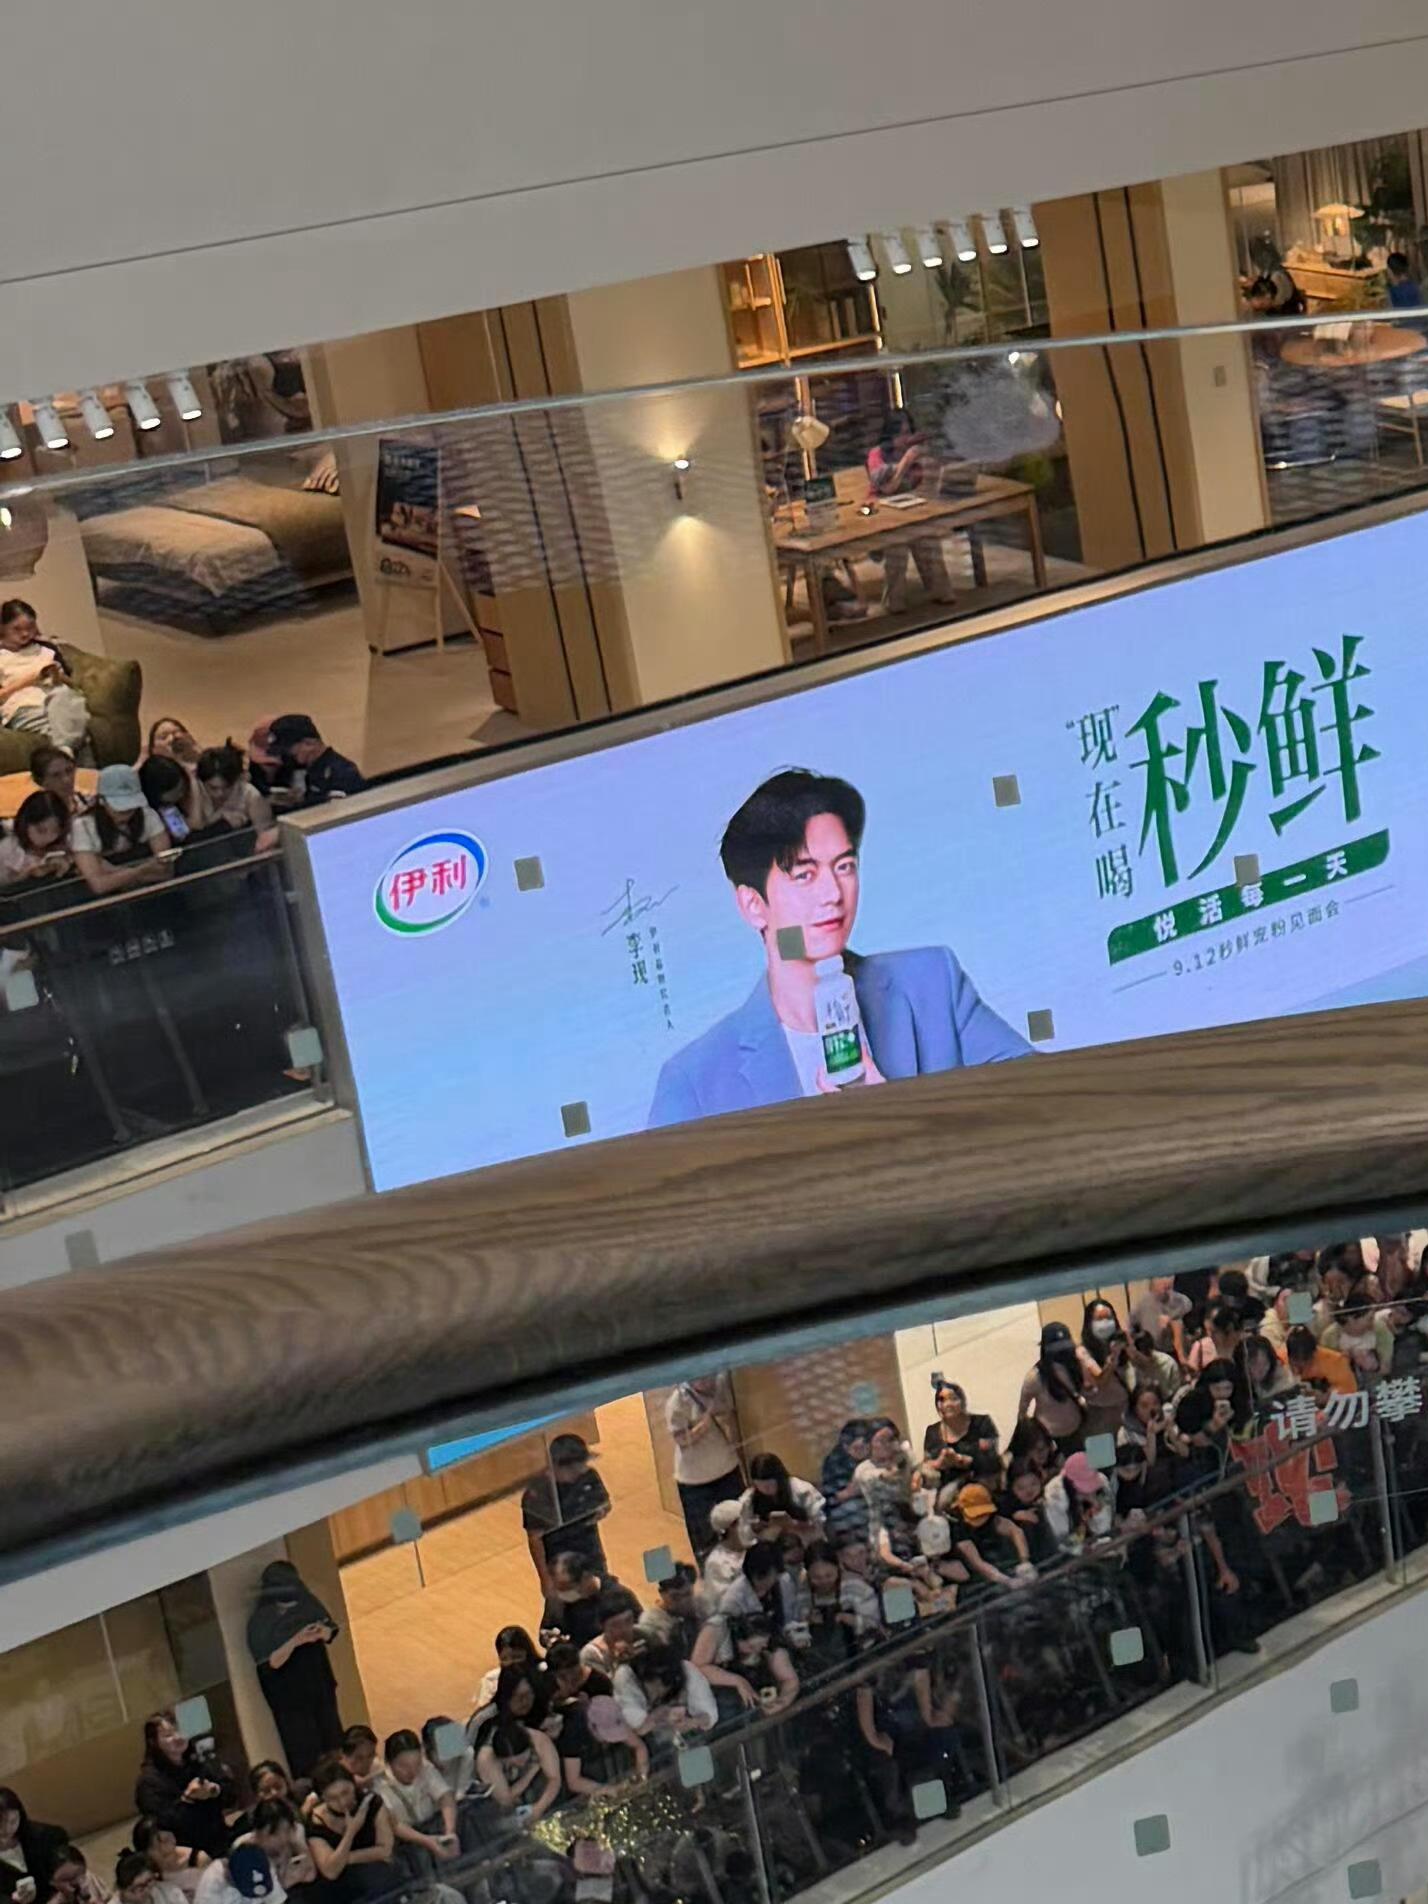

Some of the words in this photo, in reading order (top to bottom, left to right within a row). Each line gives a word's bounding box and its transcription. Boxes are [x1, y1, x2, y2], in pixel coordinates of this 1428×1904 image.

[1124, 634, 1382, 888] 秒鲜
[390, 854, 467, 912] 伊利
[1154, 850, 1348, 942] 悦活每一天
[626, 932, 648, 985] 李现
